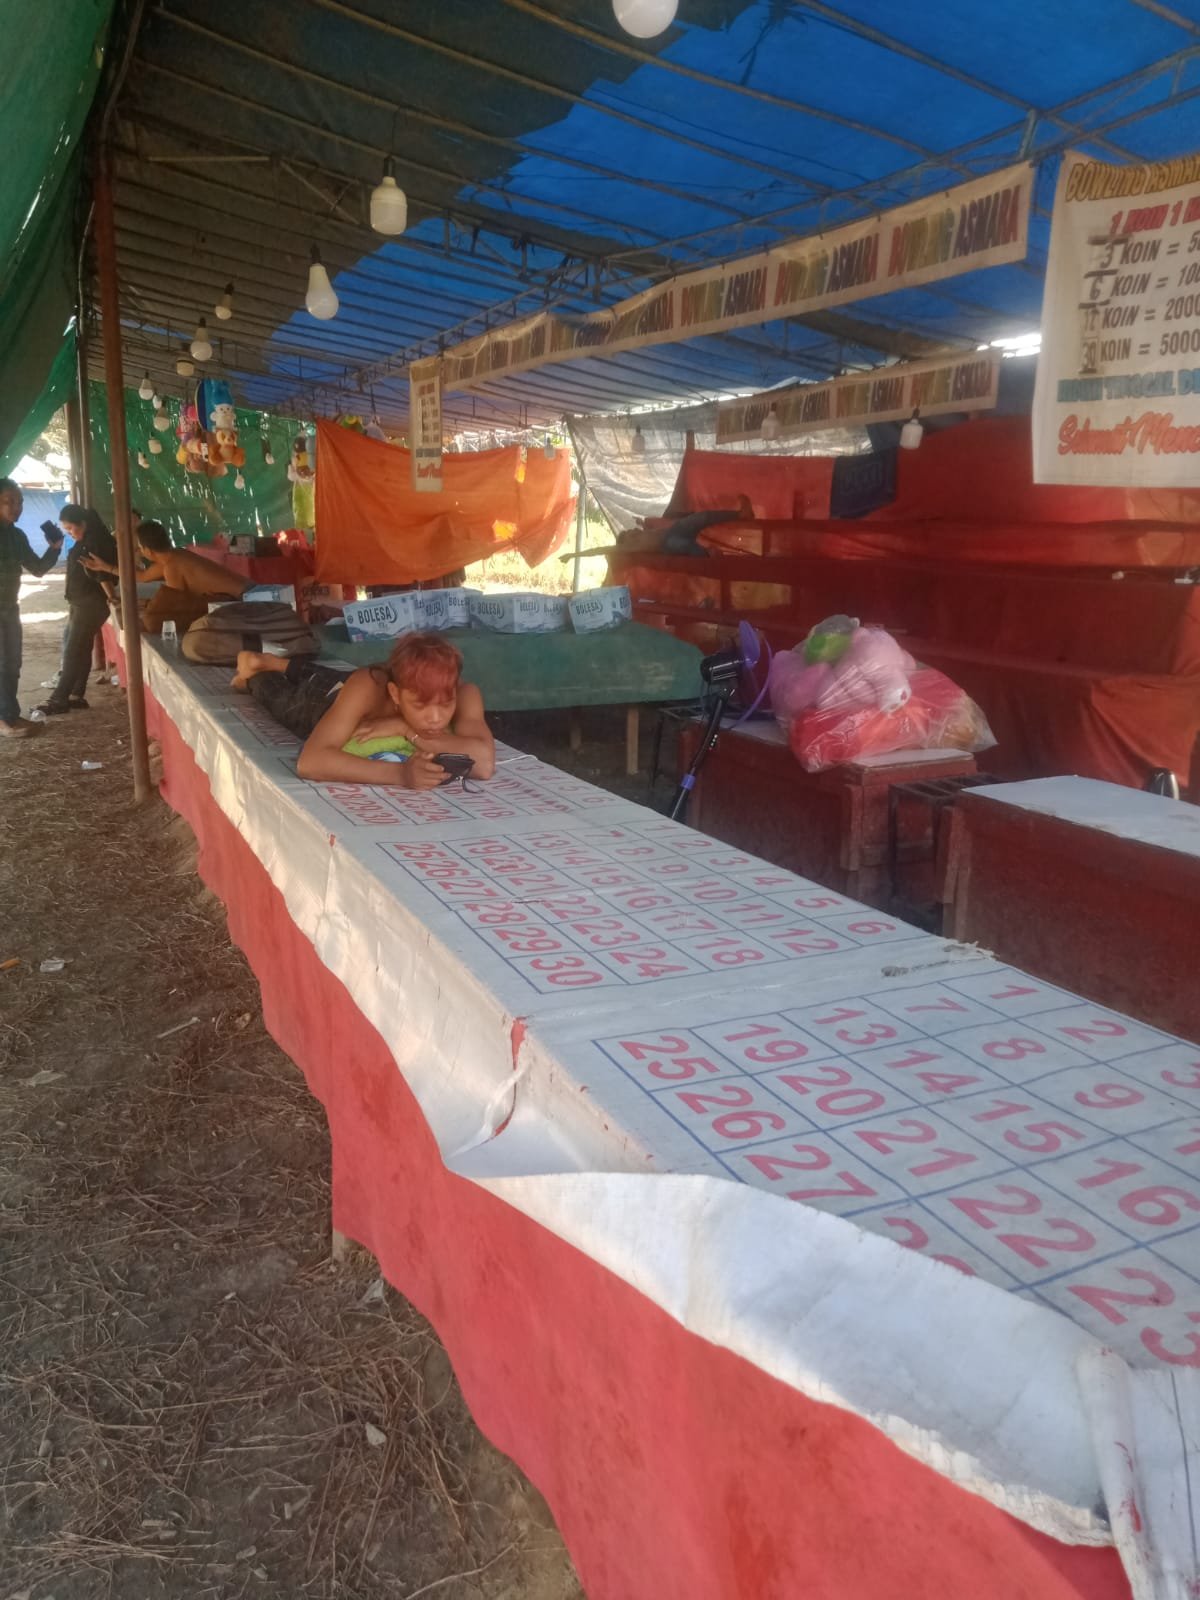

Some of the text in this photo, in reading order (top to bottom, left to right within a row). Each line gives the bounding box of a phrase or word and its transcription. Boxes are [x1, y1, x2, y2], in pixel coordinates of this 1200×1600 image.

[1120, 239, 1162, 264] KOIN
[1110, 272, 1151, 297] KOIN
[1102, 304, 1139, 329] KOIN
[1100, 337, 1132, 361] KOIN
[357, 605, 392, 625] BOLESA
[393, 842, 447, 860] 25
[461, 838, 510, 856] 19
[524, 832, 569, 850] 13
[615, 846, 655, 858] 8
[674, 838, 713, 850] 2
[415, 859, 471, 879] 26
[551, 848, 607, 867] 14
[648, 863, 690, 876] 9
[709, 856, 751, 868] 3
[436, 878, 501, 898] 27
[507, 873, 570, 894] 21
[582, 866, 637, 888] 15
[751, 875, 793, 888] 4
[613, 885, 673, 910] 16
[680, 879, 739, 901] 10
[462, 901, 529, 925] 28
[545, 896, 603, 921] 22
[722, 903, 785, 924] 11
[793, 896, 843, 910] 5
[570, 917, 641, 947] 23
[651, 909, 719, 933] 17
[846, 920, 897, 936] 6
[492, 926, 562, 952] 29
[694, 936, 765, 966] 18
[769, 928, 840, 955] 12
[529, 956, 604, 986] 30
[609, 947, 690, 979] 24
[990, 985, 1039, 1001] 1
[904, 997, 970, 1019] 7
[813, 1006, 898, 1046] 13
[1057, 1020, 1129, 1044] 2
[723, 1023, 810, 1063] 19
[982, 1037, 1047, 1061] 8
[618, 1034, 720, 1082] 25
[884, 1049, 984, 1094] 14
[777, 1066, 886, 1117] 20
[1073, 1082, 1146, 1114] 9
[673, 1084, 787, 1141] 26
[969, 1099, 1089, 1154] 15
[853, 1118, 980, 1178] 21
[742, 1143, 879, 1201] 27
[1074, 1157, 1200, 1227] 16
[946, 1184, 1098, 1269] 22
